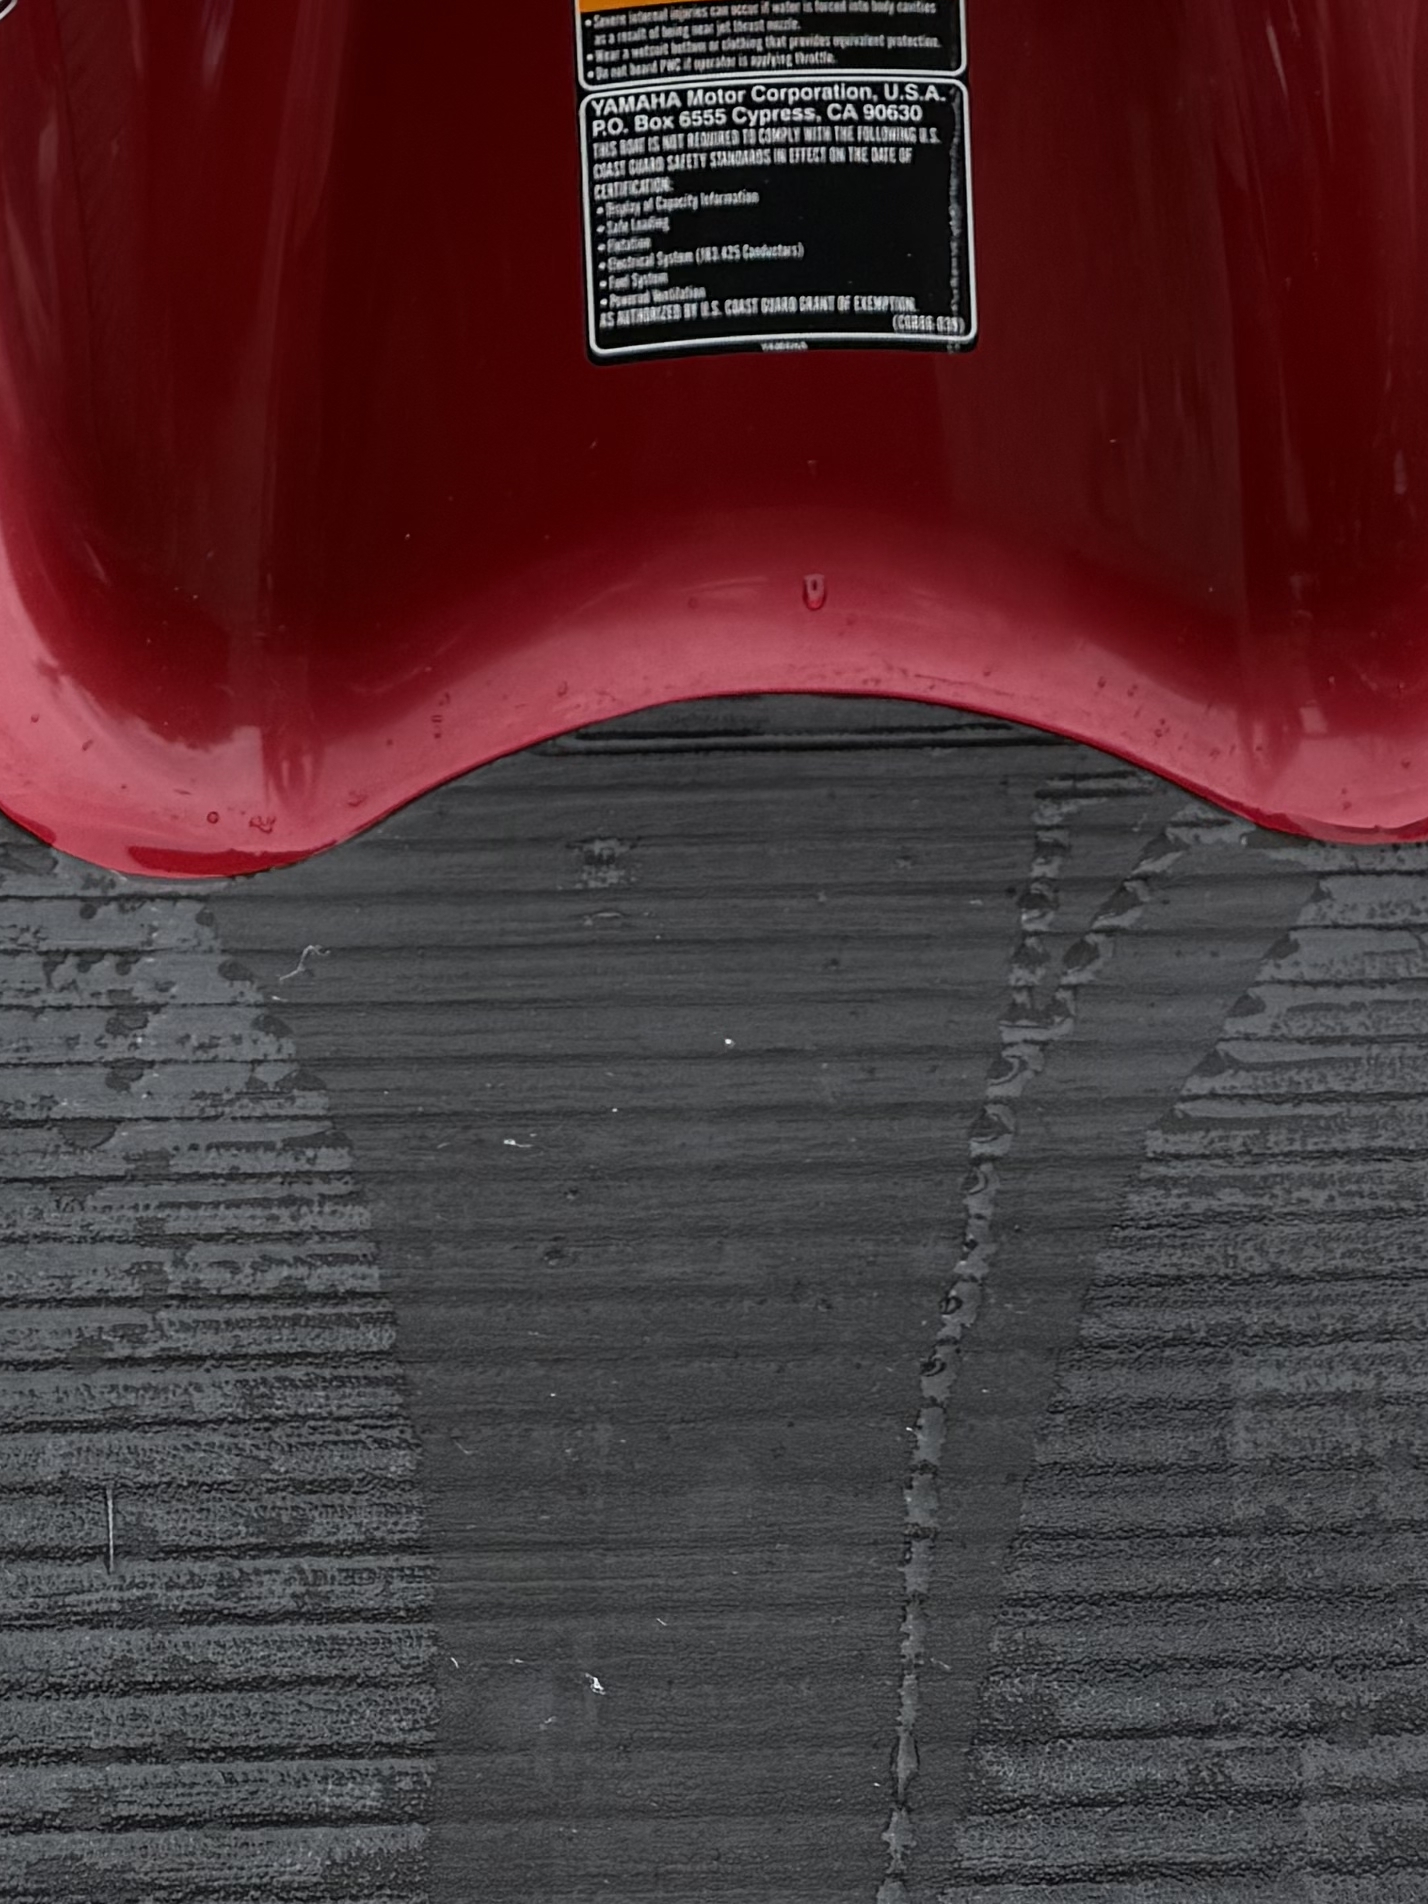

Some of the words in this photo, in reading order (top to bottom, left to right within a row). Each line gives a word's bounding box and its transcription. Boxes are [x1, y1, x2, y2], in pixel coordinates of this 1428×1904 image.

[595, 49, 621, 63] Wear
[622, 48, 630, 59] a
[631, 43, 669, 58] wetsuit
[670, 40, 707, 54] bottom
[708, 40, 720, 52] or
[721, 37, 763, 52] clothing
[765, 36, 787, 48] that
[789, 35, 831, 50] provides
[833, 35, 885, 49] equivalent
[887, 35, 942, 49] protection.
[595, 66, 609, 80] Do
[610, 64, 628, 79] not
[629, 60, 658, 76] board
[660, 58, 681, 73] PWC
[683, 57, 692, 70] if
[694, 56, 736, 72] operator
[738, 54, 748, 67] is
[750, 53, 792, 68] applying
[794, 51, 836, 65] throttle.
[591, 92, 682, 117] YAMAHA
[687, 88, 746, 107] Motor
[750, 83, 879, 106] Corporation,
[883, 83, 946, 102] U.S.A.
[591, 117, 629, 139] P.O.
[634, 114, 674, 132] Box
[678, 108, 727, 128] 6555
[731, 106, 822, 127] Cypress,
[826, 103, 859, 121] CA
[862, 104, 922, 122] 90630
[593, 141, 618, 159] THIS
[619, 137, 646, 155] BOAT
[648, 136, 661, 152] IS
[662, 133, 685, 151] NOT
[687, 129, 740, 149] REQUIRED
[742, 128, 757, 145] TO
[758, 126, 802, 144] COMPLY
[803, 126, 833, 143] WITH
[834, 125, 856, 142] THE
[857, 125, 917, 144] FOLLOWING
[919, 127, 941, 144] U.S.
[593, 160, 626, 180] COAST
[628, 156, 665, 176] GUARD
[667, 153, 708, 172] SAFETY
[710, 148, 772, 169] STANDARDS
[773, 147, 787, 164] IN
[789, 147, 827, 164] EFFECT
[829, 147, 846, 163] ON
[848, 147, 870, 163] THE
[871, 147, 897, 163] DATE
[898, 148, 913, 164] OF
[599, 312, 615, 329] AS
[617, 304, 682, 327] AUTHORIZED
[683, 302, 698, 318] BY
[700, 300, 723, 317] U.S.
[724, 298, 759, 316] COAST
[761, 296, 798, 314] GUARD
[799, 295, 835, 312] GRANT
[837, 295, 852, 312] OF
[853, 295, 919, 313] EXEMPTION.
